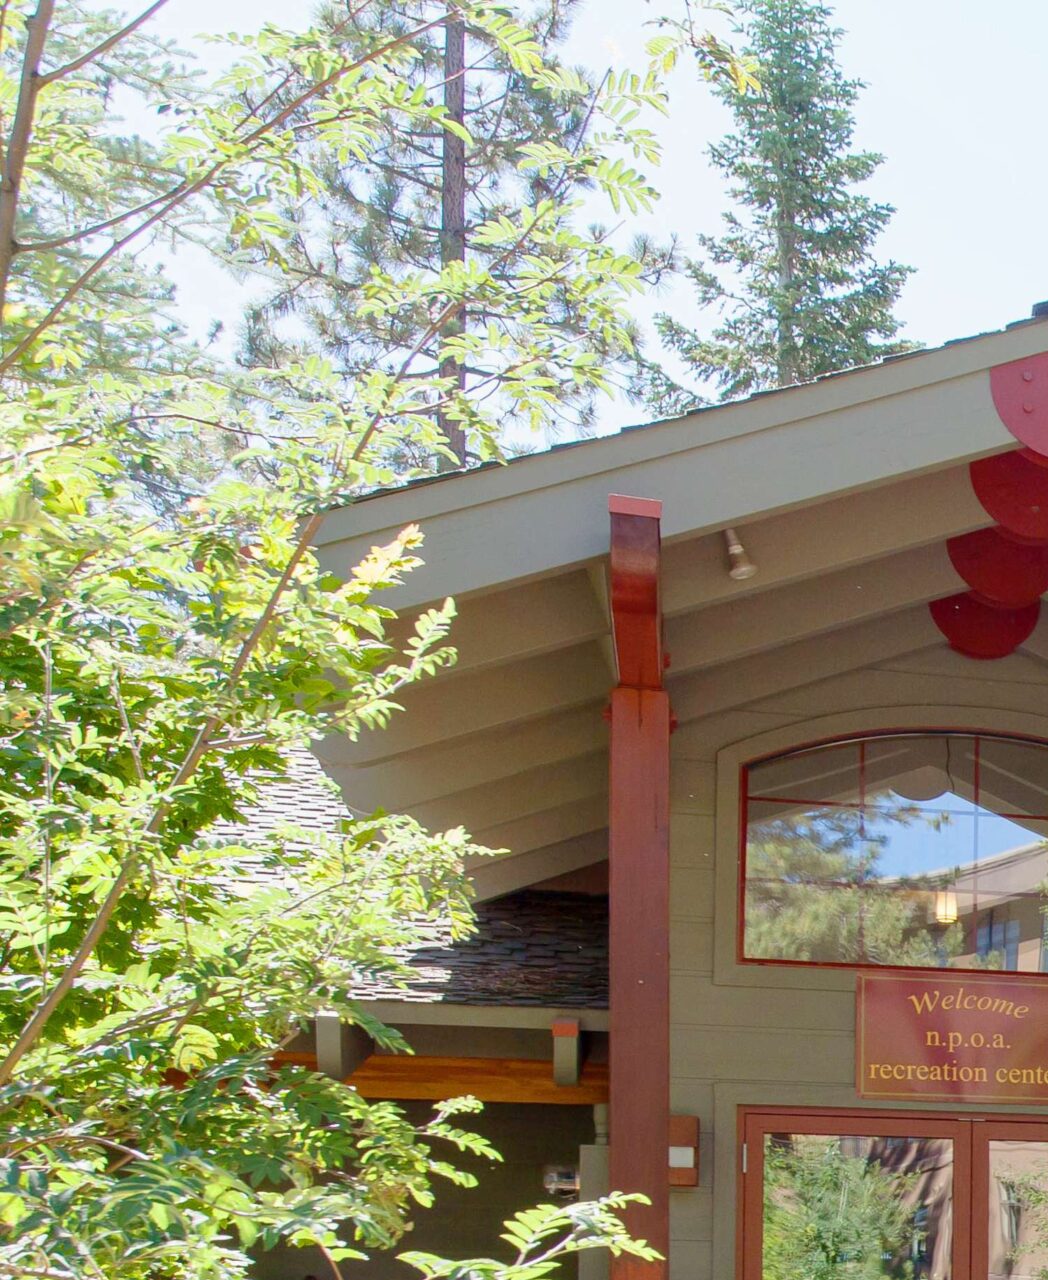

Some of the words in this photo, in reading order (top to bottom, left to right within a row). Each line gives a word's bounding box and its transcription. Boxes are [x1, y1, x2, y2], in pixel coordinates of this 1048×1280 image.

[907, 987, 1030, 1019] Welcome
[926, 1030, 1012, 1053] n.p.o.a.
[868, 1059, 988, 1082] recreation
